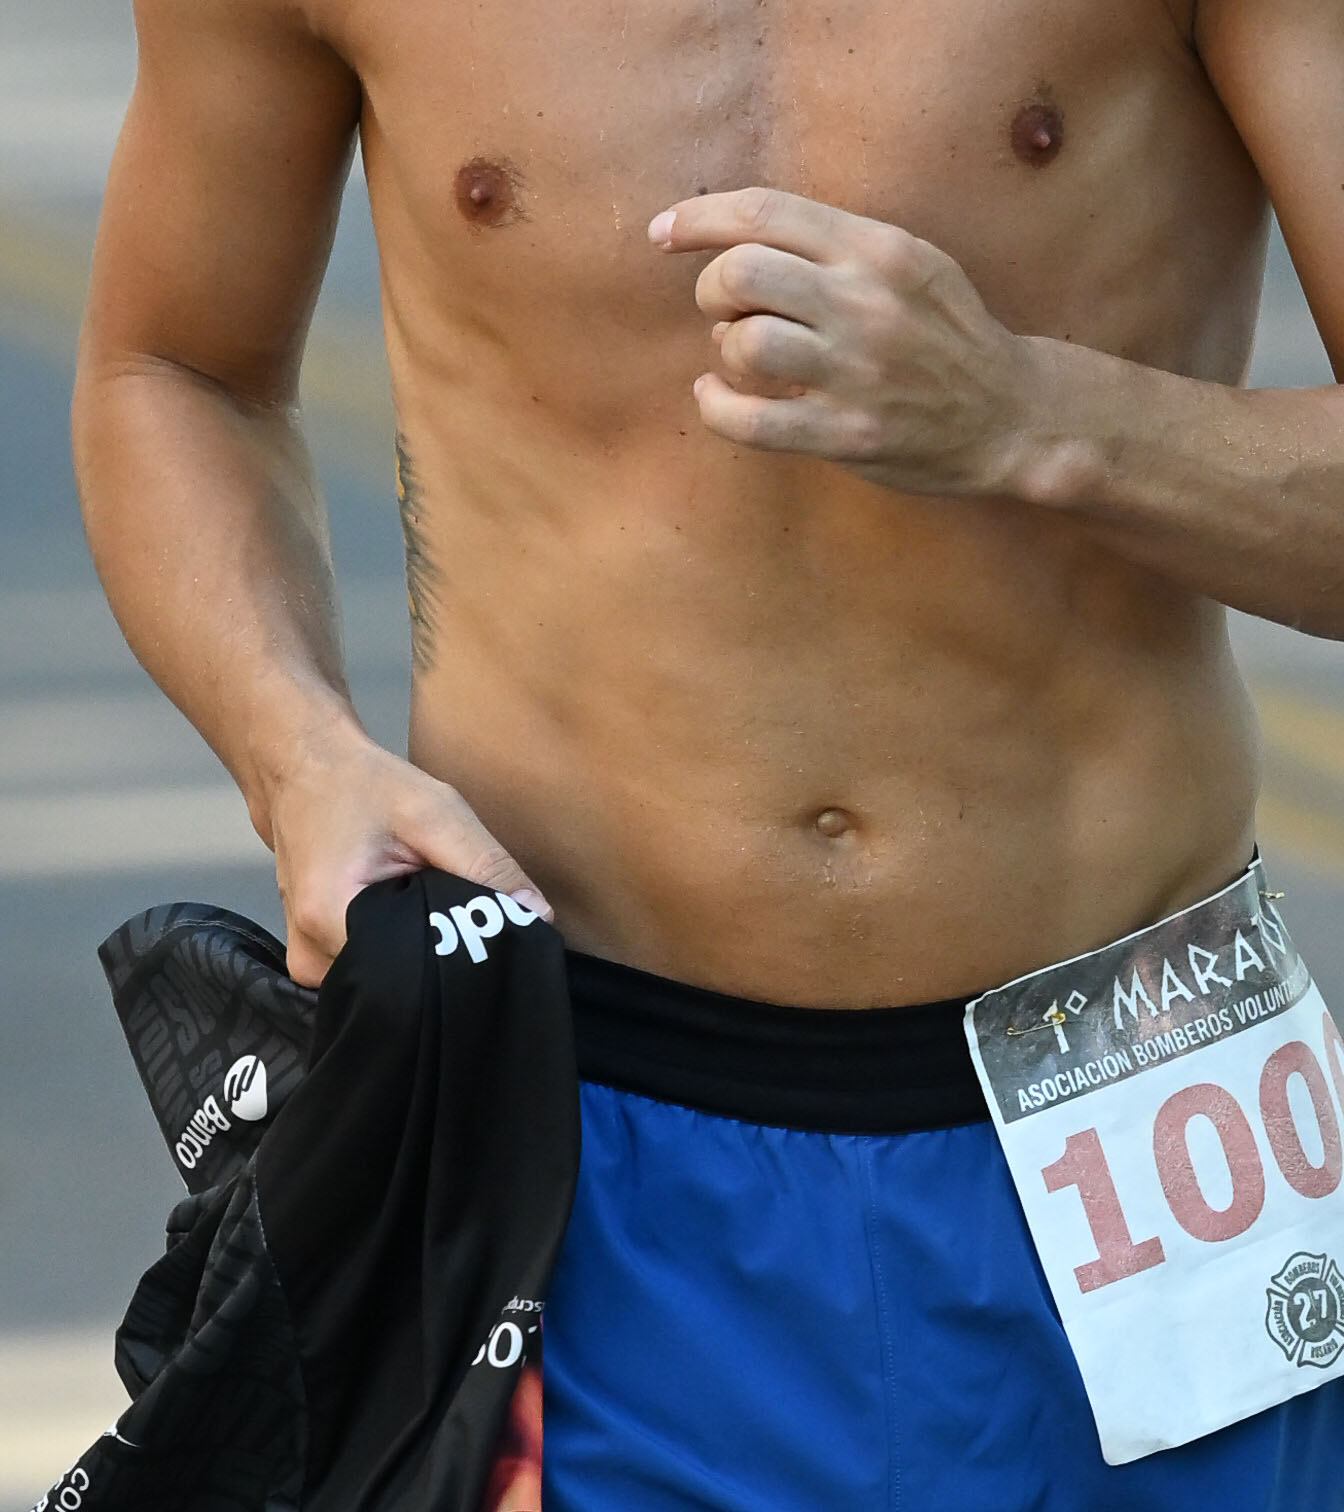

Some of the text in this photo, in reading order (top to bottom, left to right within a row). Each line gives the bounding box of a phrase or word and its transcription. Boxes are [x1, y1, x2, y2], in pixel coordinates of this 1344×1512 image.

[1017, 1050, 1133, 1112] ASOCIACIÓN
[1132, 1008, 1234, 1066] BOMBEROS
[175, 1094, 232, 1169] Banco
[1293, 1289, 1328, 1331] 27
